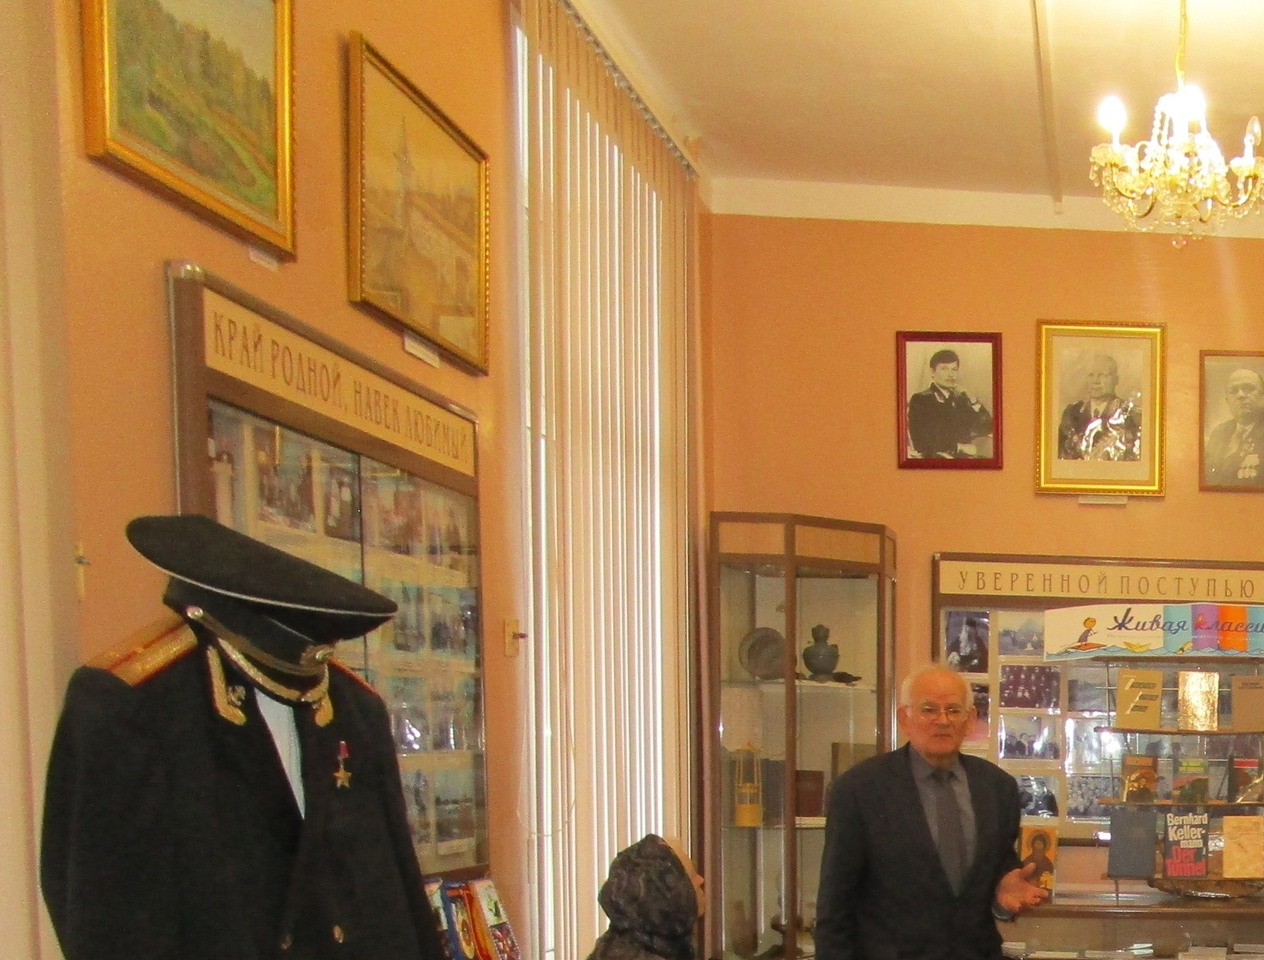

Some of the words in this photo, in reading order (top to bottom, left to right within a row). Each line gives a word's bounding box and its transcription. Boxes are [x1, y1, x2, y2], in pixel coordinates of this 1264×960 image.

[213, 311, 265, 373] КРАЙ
[353, 380, 401, 434] НАВЕК
[406, 405, 469, 463] ЛЮБИМЫЙ
[957, 570, 1108, 595] УВЕРЕННОЙ
[1119, 575, 1255, 599] ПОСТУПЬЮ
[1107, 607, 1190, 634] Живая
[1167, 813, 1208, 825] Bernhard
[1168, 825, 1206, 841] Keller-
[1172, 846, 1197, 862] Der
